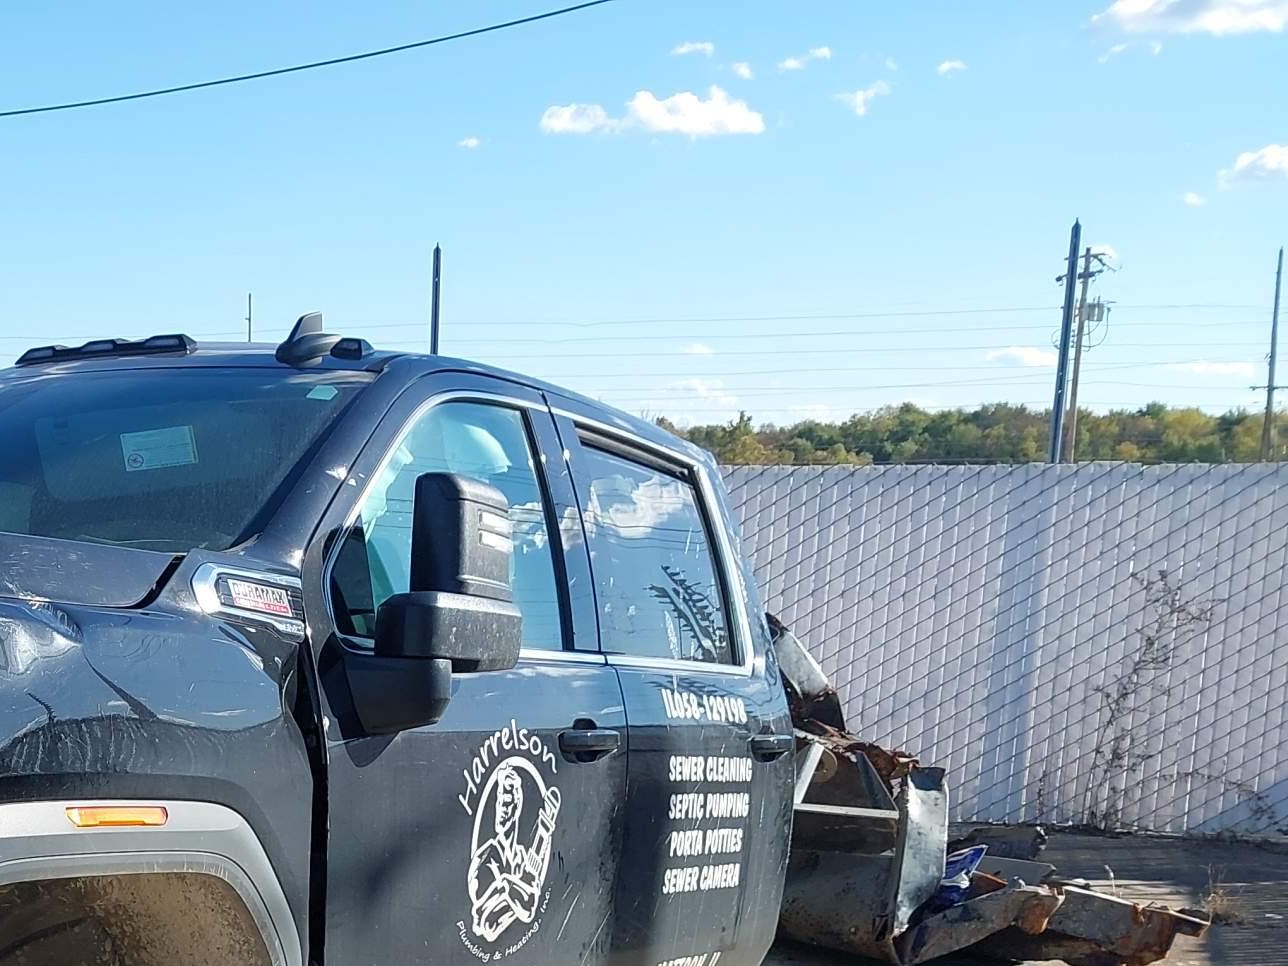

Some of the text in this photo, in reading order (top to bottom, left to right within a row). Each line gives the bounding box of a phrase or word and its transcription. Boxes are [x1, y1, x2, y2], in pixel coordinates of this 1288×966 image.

[458, 718, 558, 816] Harrelson
[669, 755, 752, 782] SEWER CLEANING
[669, 793, 749, 819] SEPTIC PUMPING
[670, 828, 743, 856] PORTA POTTIES
[662, 863, 740, 894] SEWER CAMERA
[456, 920, 491, 963] Plumbing
[493, 951, 503, 960] &
[540, 887, 552, 914] Inc.
